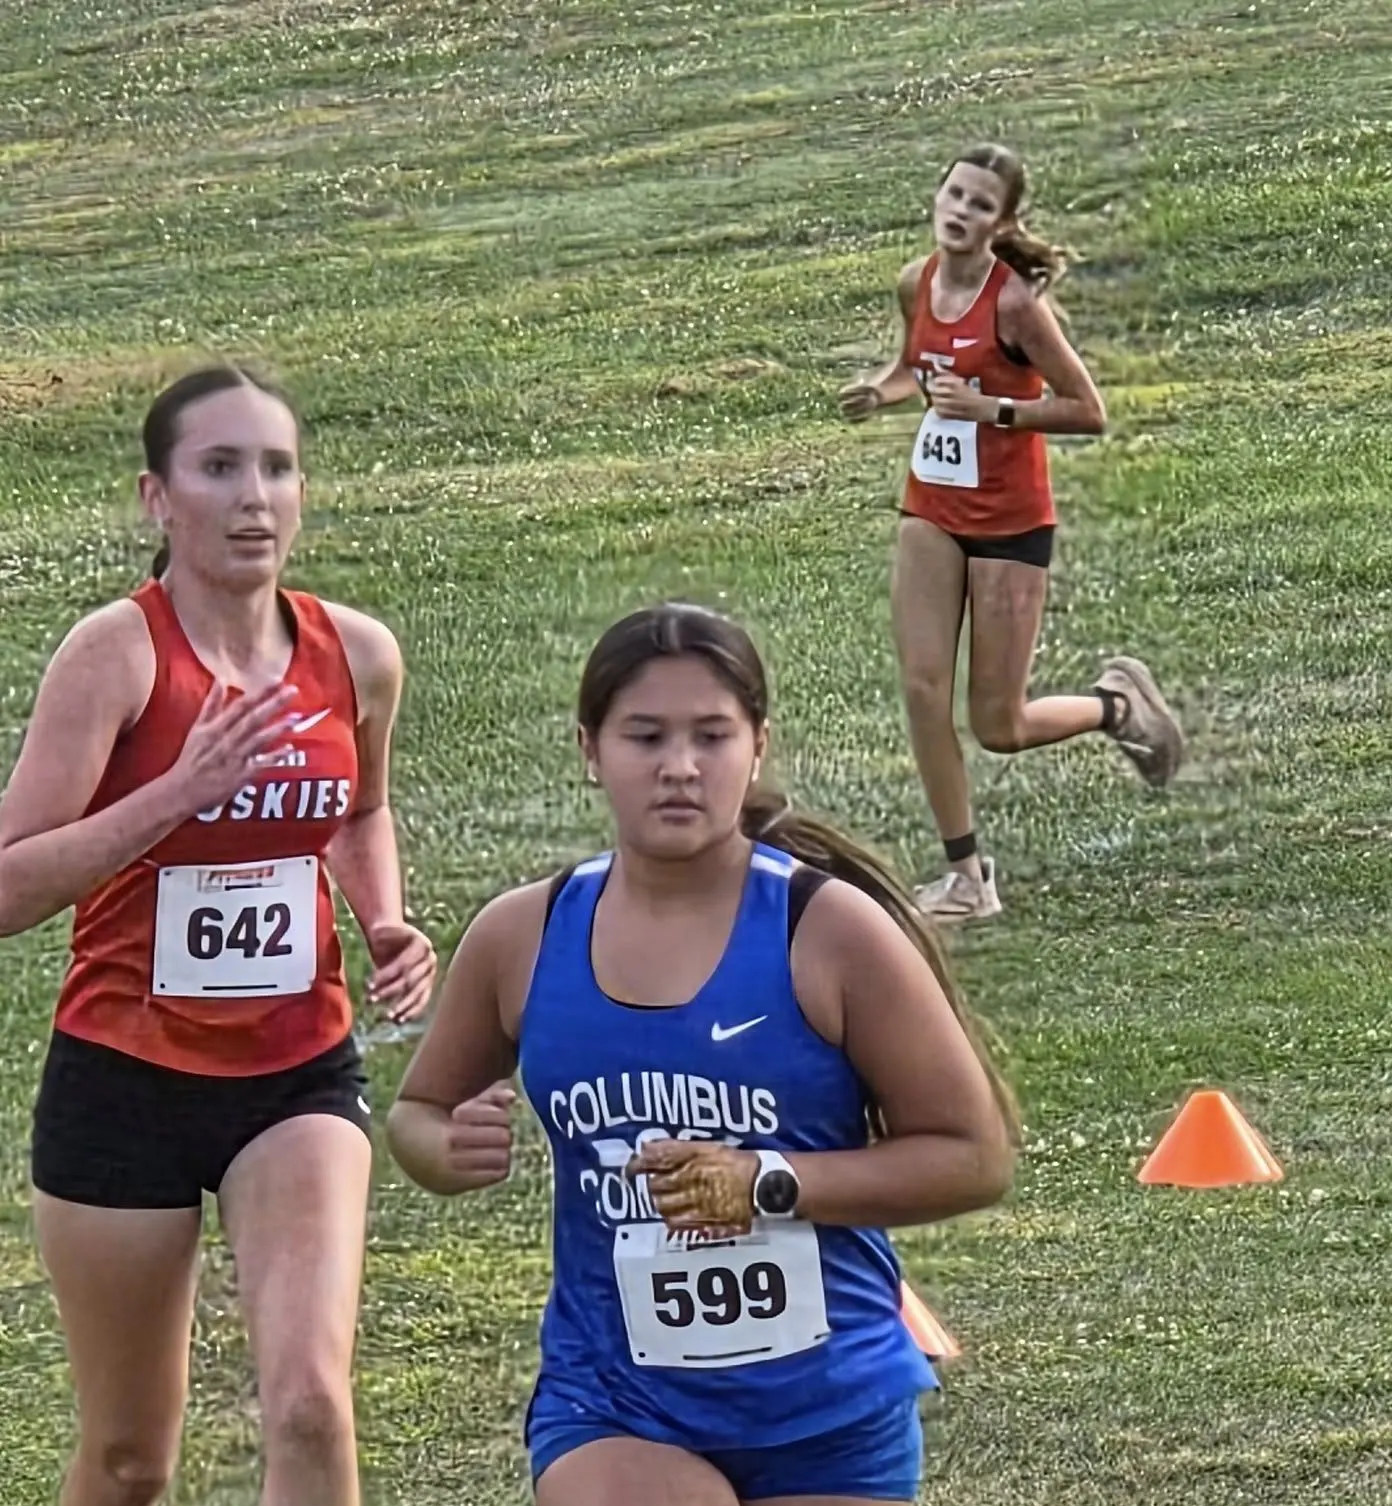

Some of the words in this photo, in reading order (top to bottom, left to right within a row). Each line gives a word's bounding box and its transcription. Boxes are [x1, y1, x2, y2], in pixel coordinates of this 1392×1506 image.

[196, 779, 350, 822] SKIES
[187, 903, 292, 960] 642
[551, 1071, 779, 1139] COLUMBUS
[651, 1261, 787, 1328] 599
